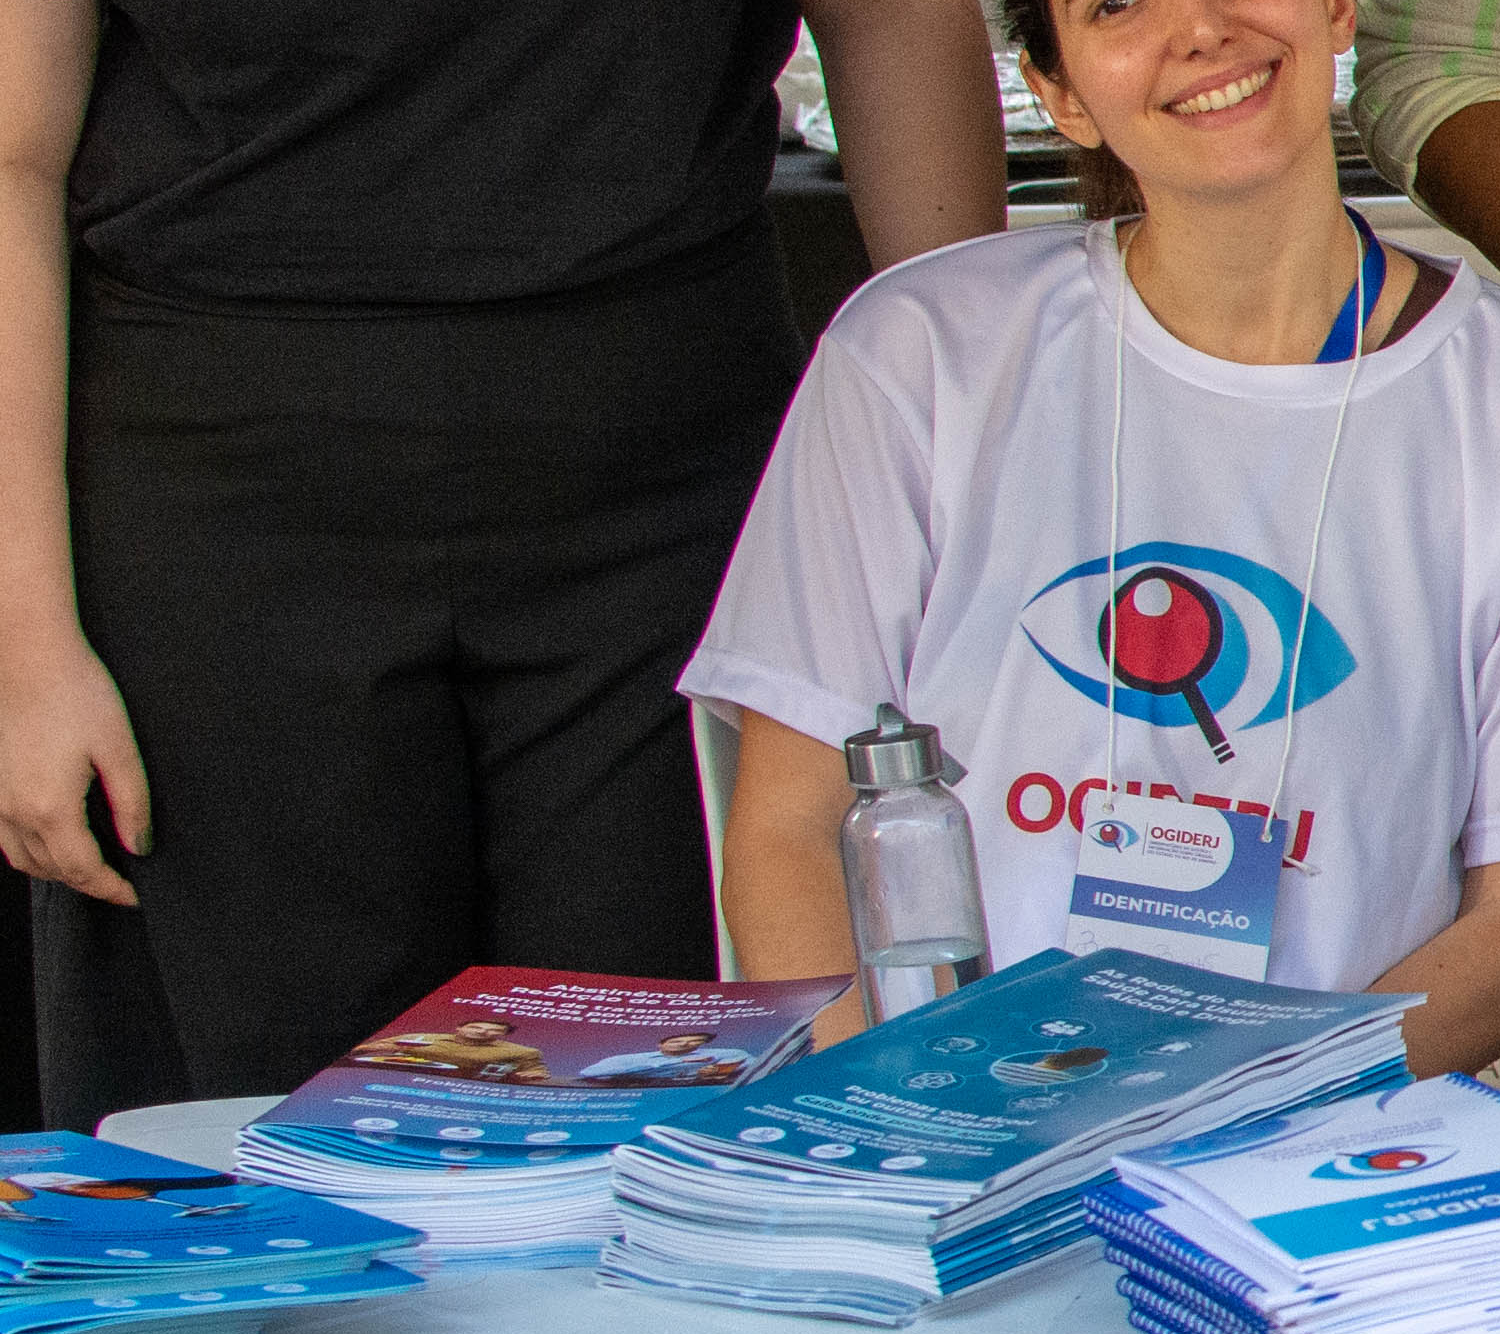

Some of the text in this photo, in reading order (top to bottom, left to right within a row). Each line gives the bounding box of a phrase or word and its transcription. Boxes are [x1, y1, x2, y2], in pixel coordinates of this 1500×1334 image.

[1150, 826, 1221, 849] OGIDERJ
[1092, 891, 1251, 931] IDENTIFICAÇÃO
[509, 985, 622, 1004] Redução
[631, 997, 661, 1006] de
[549, 983, 701, 1000] Abstinência
[1081, 974, 1149, 997] Saúde
[1149, 993, 1201, 1009] para
[1096, 968, 1128, 981] As
[1129, 975, 1196, 997] Redes
[1196, 994, 1225, 1005] do
[452, 997, 583, 1016] transtornos
[585, 1010, 630, 1020] por
[634, 1012, 670, 1021] uso
[670, 1013, 700, 1021] de
[475, 993, 555, 1008] formas
[561, 1002, 588, 1010] de
[594, 1004, 721, 1016] tratamento
[511, 1009, 584, 1023] outras
[1174, 1009, 1190, 1017] e
[799, 1094, 845, 1112] Saiba
[845, 1107, 889, 1123] onde
[843, 1084, 939, 1113] Problemas
[845, 1095, 870, 1106] ou
